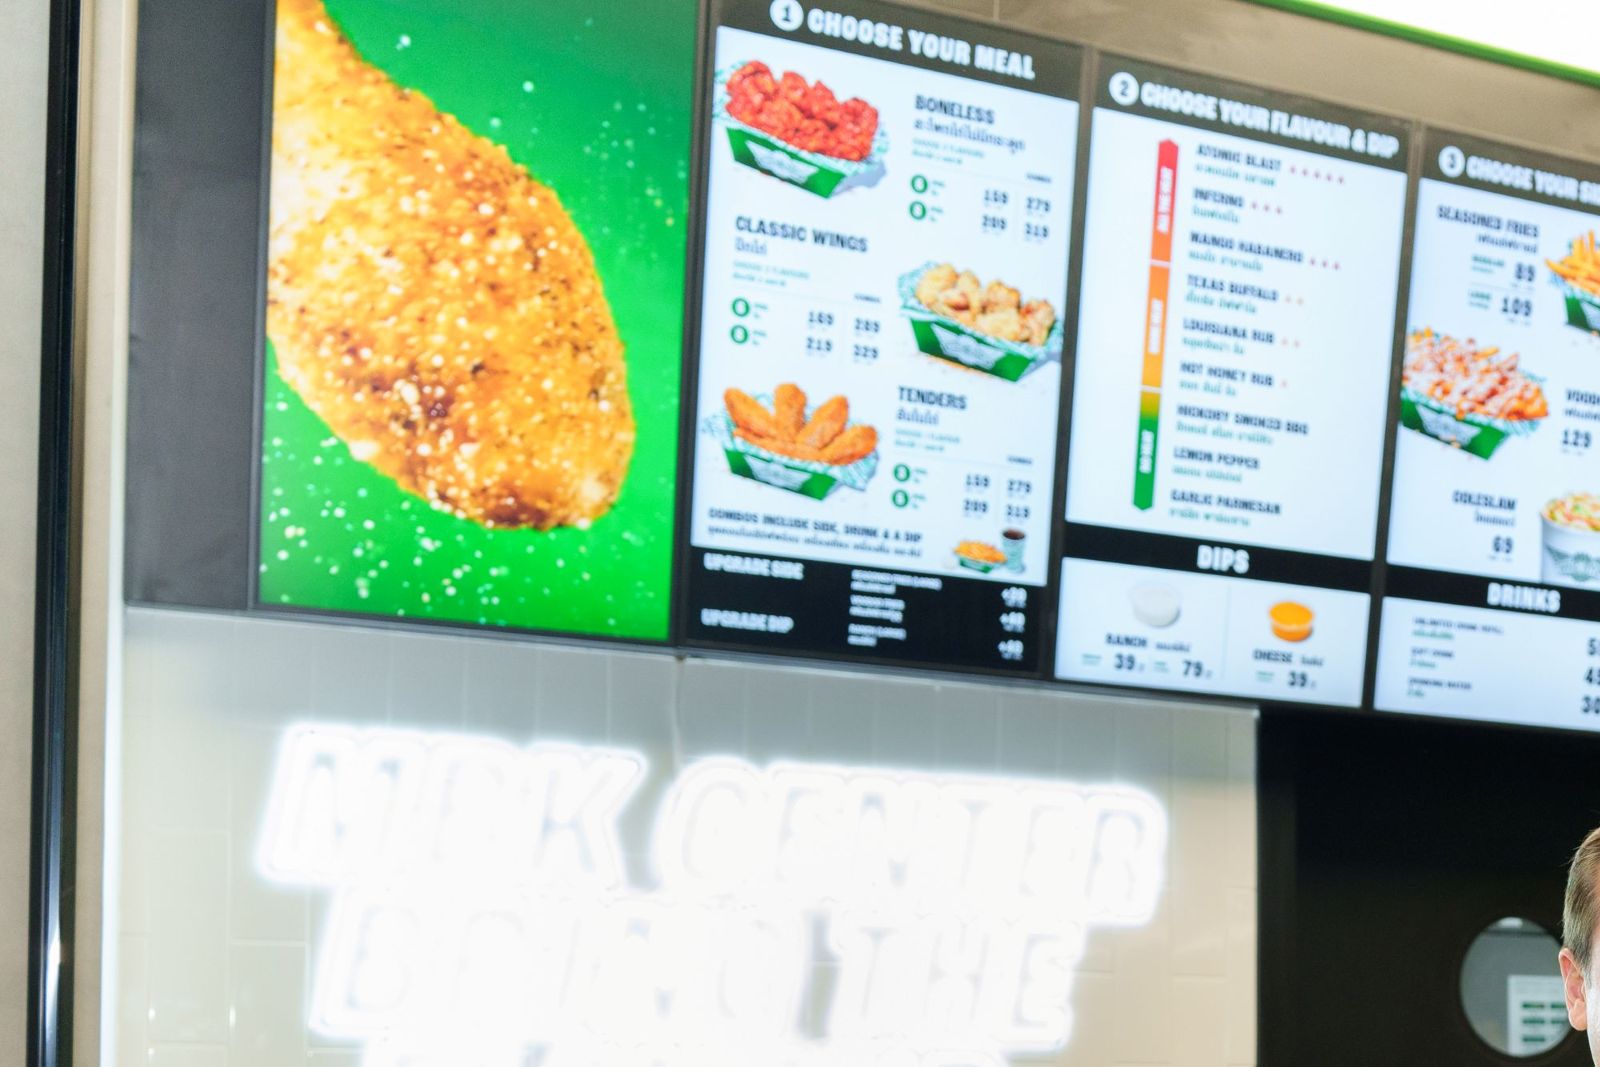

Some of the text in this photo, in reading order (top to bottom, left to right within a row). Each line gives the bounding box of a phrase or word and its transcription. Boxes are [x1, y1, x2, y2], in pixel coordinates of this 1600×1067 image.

[807, 8, 904, 51] CHOOSE
[907, 29, 972, 66] YOUR
[975, 45, 1036, 80] MEAL
[914, 94, 995, 125] BONELESS
[1140, 81, 1218, 121] CHOOSE
[1219, 98, 1270, 133] YOUR
[1271, 109, 1352, 149] FLAVOUR
[1367, 131, 1400, 158] DIP
[1466, 154, 1534, 191] CHOOSE
[1534, 170, 1580, 201] YOUR
[735, 215, 869, 253] CLASSIC WINGS
[1437, 203, 1540, 239] SEASONED FRIES
[898, 384, 967, 411] TENDERS
[1453, 488, 1518, 511] COLESLAW
[1196, 544, 1250, 574] DIPS
[1486, 581, 1562, 614] DRINKS
[1105, 632, 1148, 650] RANCH
[1253, 649, 1294, 666] CHEESE
